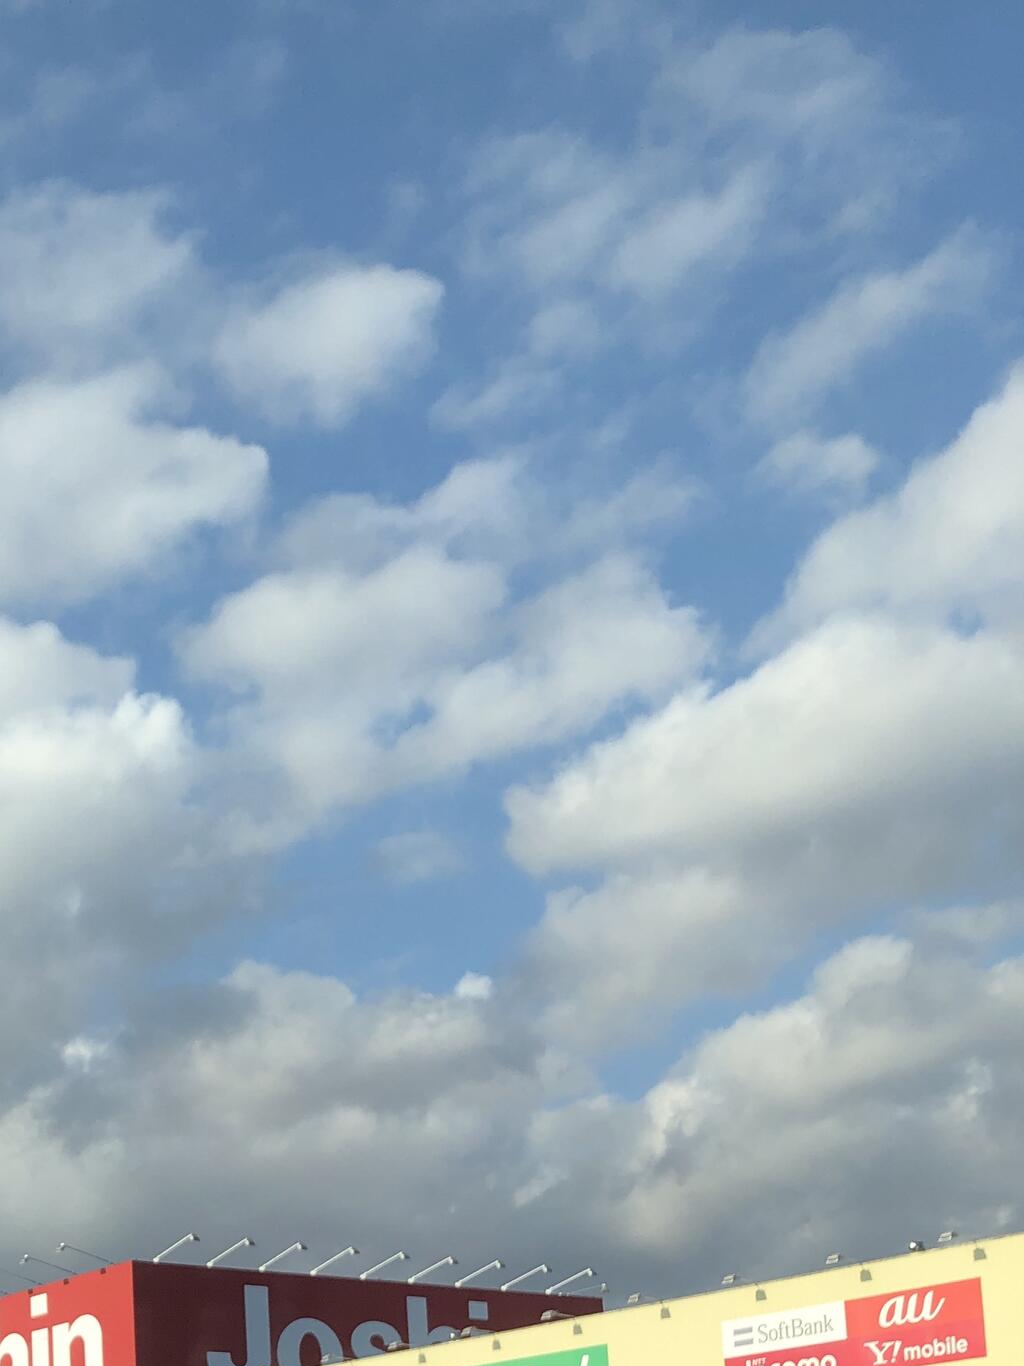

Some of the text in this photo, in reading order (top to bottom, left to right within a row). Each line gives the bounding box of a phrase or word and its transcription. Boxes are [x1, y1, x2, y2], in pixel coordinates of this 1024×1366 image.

[878, 1289, 946, 1329] au
[756, 1314, 835, 1345] SoftBank
[903, 1335, 969, 1362] mobile
